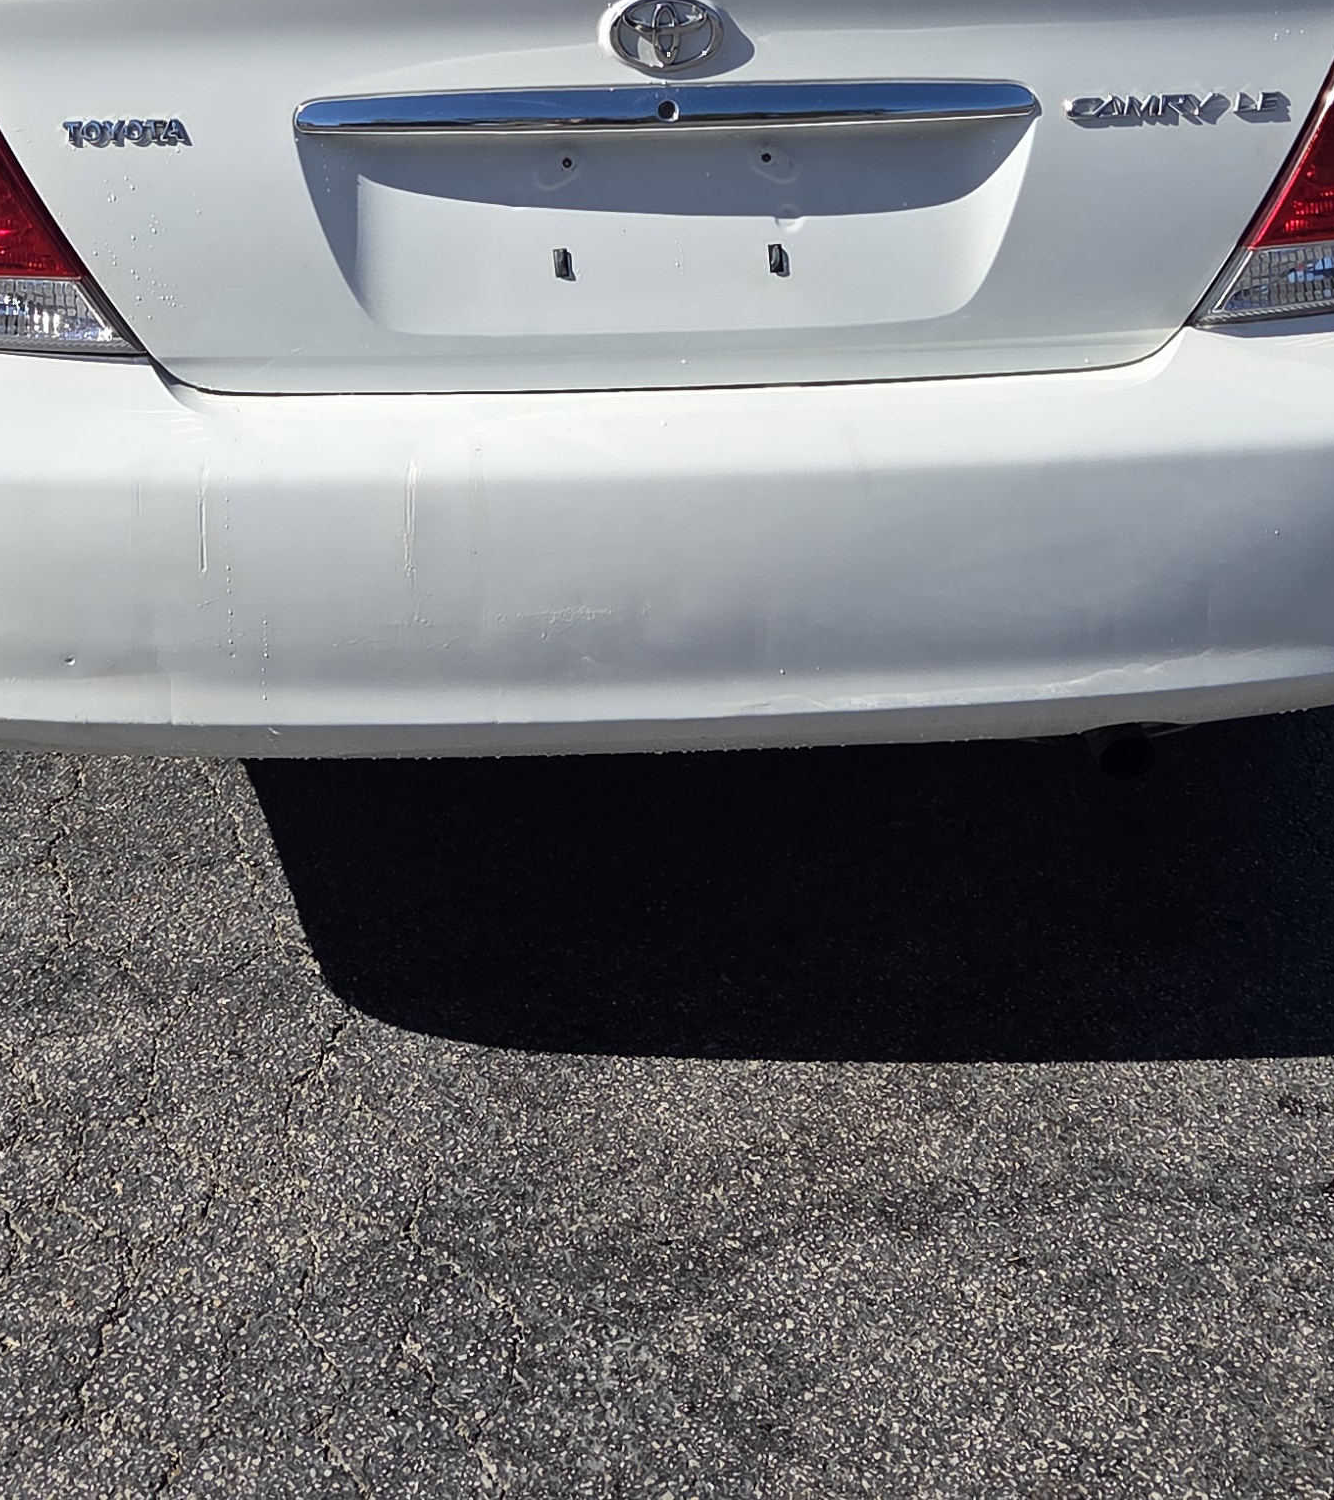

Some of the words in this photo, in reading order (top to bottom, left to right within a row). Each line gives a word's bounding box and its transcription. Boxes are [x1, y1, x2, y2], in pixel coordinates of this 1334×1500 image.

[1065, 92, 1221, 120] CAMRY
[1233, 91, 1283, 113] LE
[63, 118, 188, 145] TOYOTA
